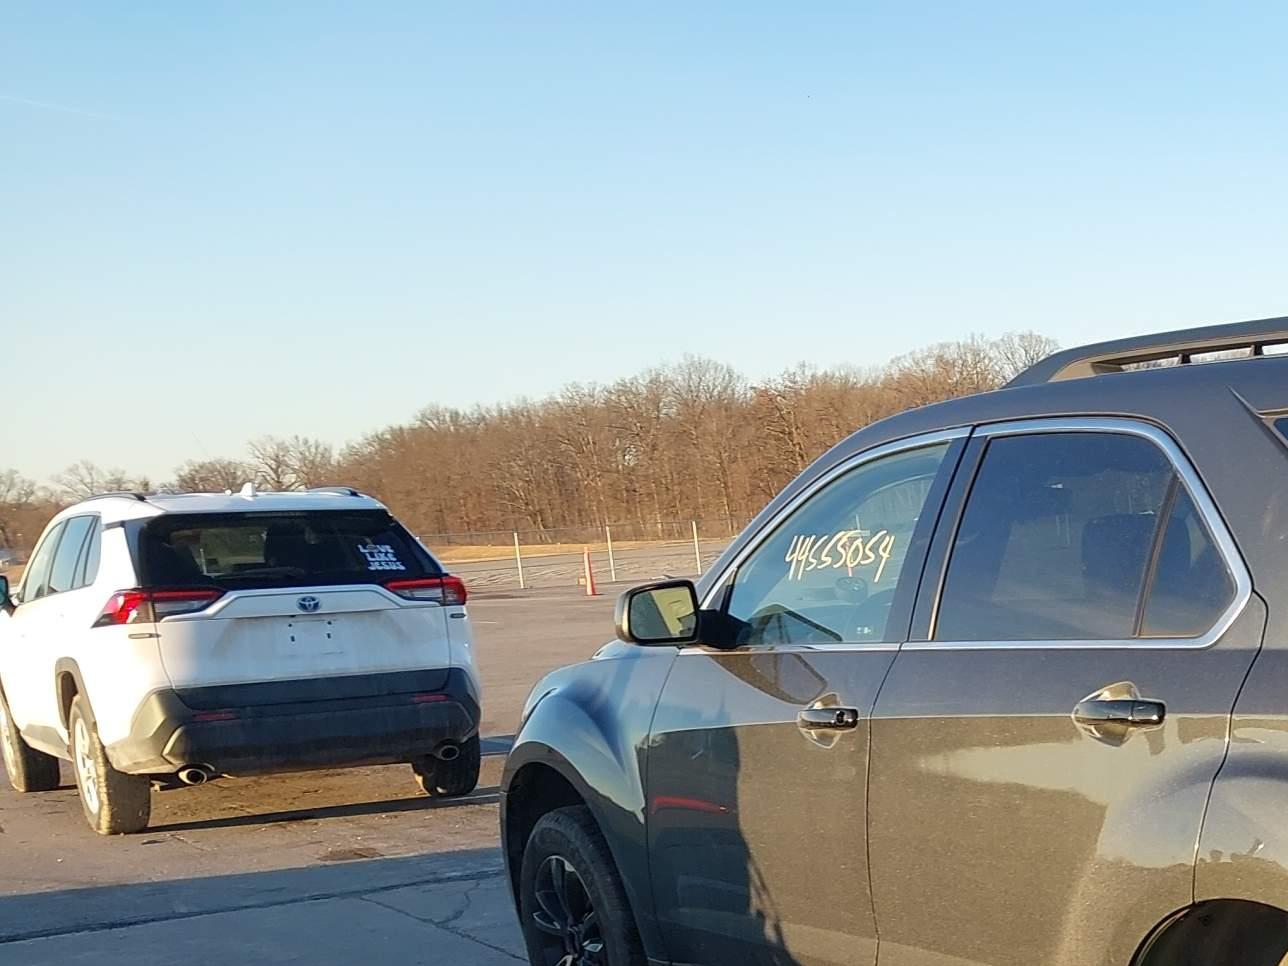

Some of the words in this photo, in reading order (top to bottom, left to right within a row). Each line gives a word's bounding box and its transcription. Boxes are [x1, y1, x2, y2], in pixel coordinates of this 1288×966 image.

[365, 552, 398, 562] LIKE
[785, 529, 896, 583] 44555054
[367, 561, 406, 571] JESUS
